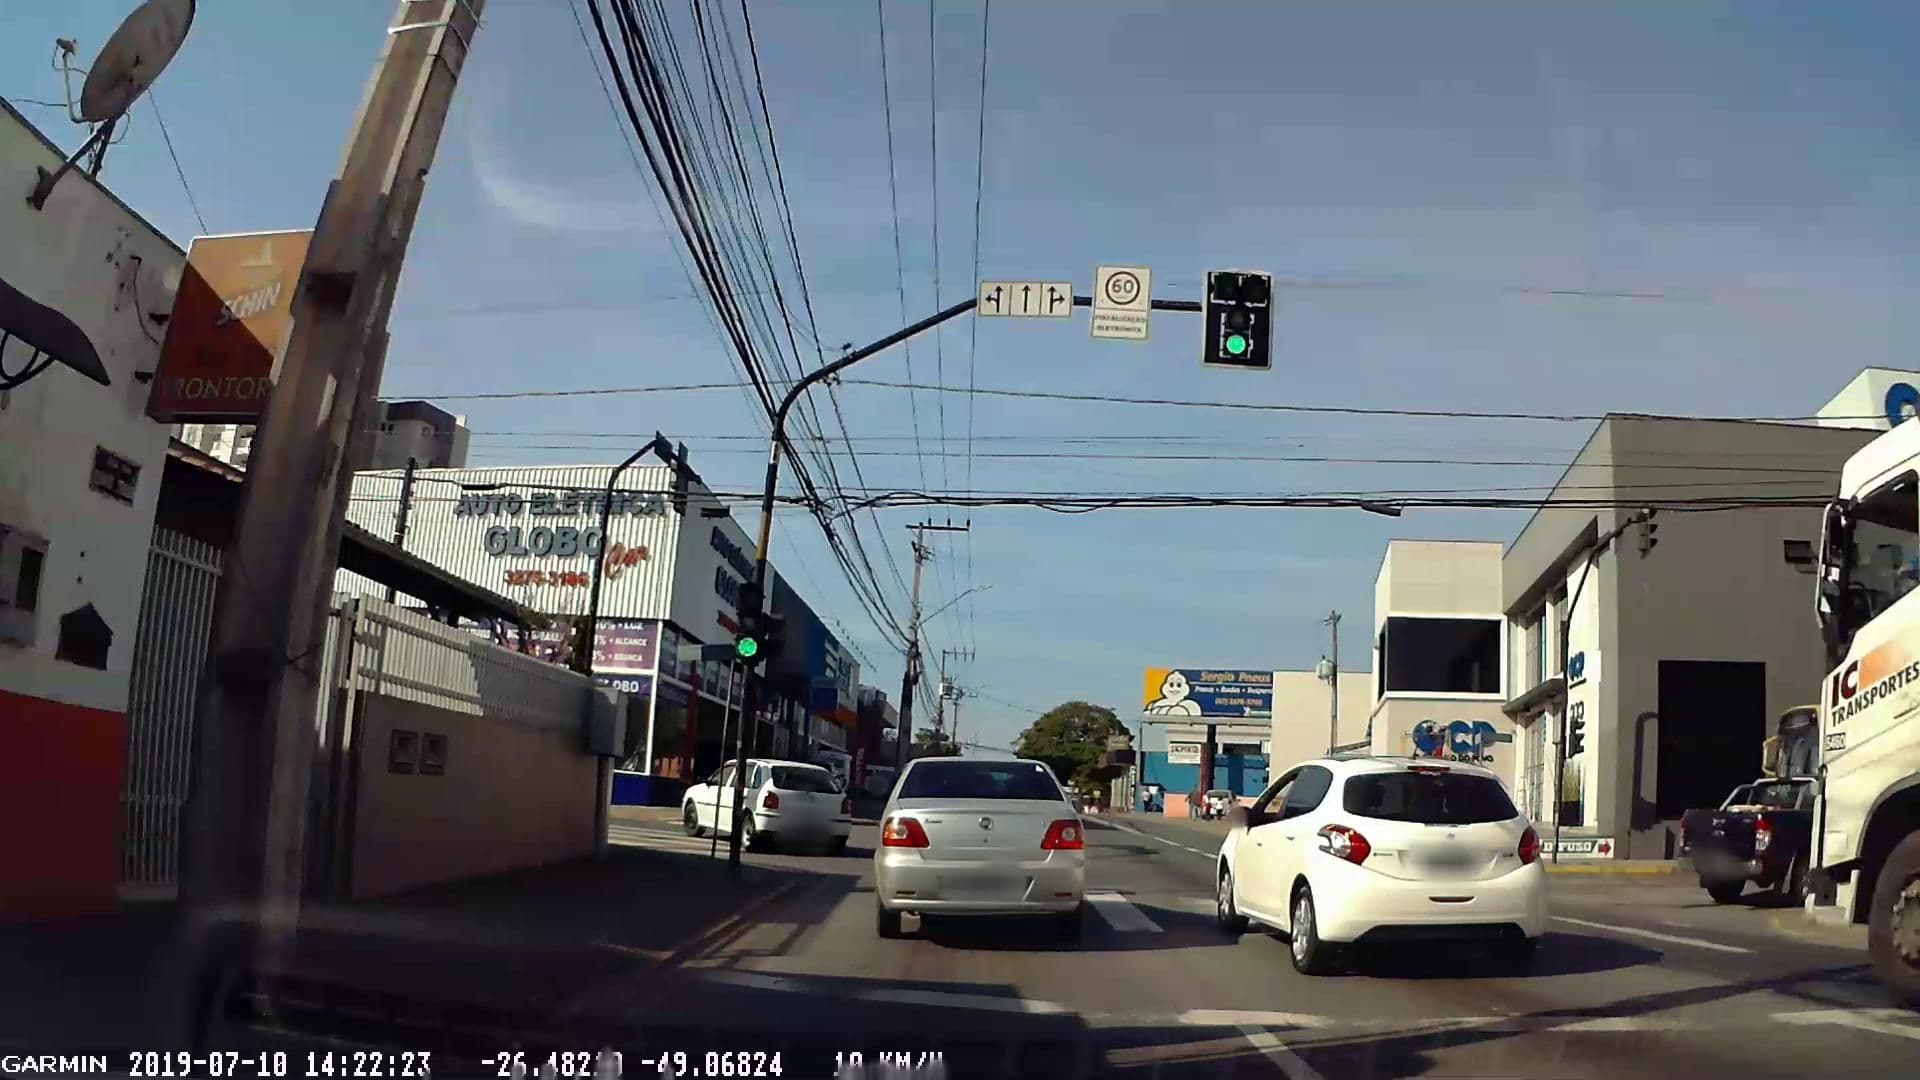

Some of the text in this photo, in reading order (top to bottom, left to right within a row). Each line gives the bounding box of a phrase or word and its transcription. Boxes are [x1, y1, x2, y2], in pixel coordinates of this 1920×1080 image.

[1112, 279, 1134, 293] 60
[454, 493, 523, 516] AUTO
[484, 526, 604, 557] GLOBO
[614, 636, 648, 647] ALCANCE
[1200, 672, 1271, 683] Sergio Pneus
[1831, 660, 1859, 709] IC
[1831, 660, 1920, 728] TRANSPORTES
